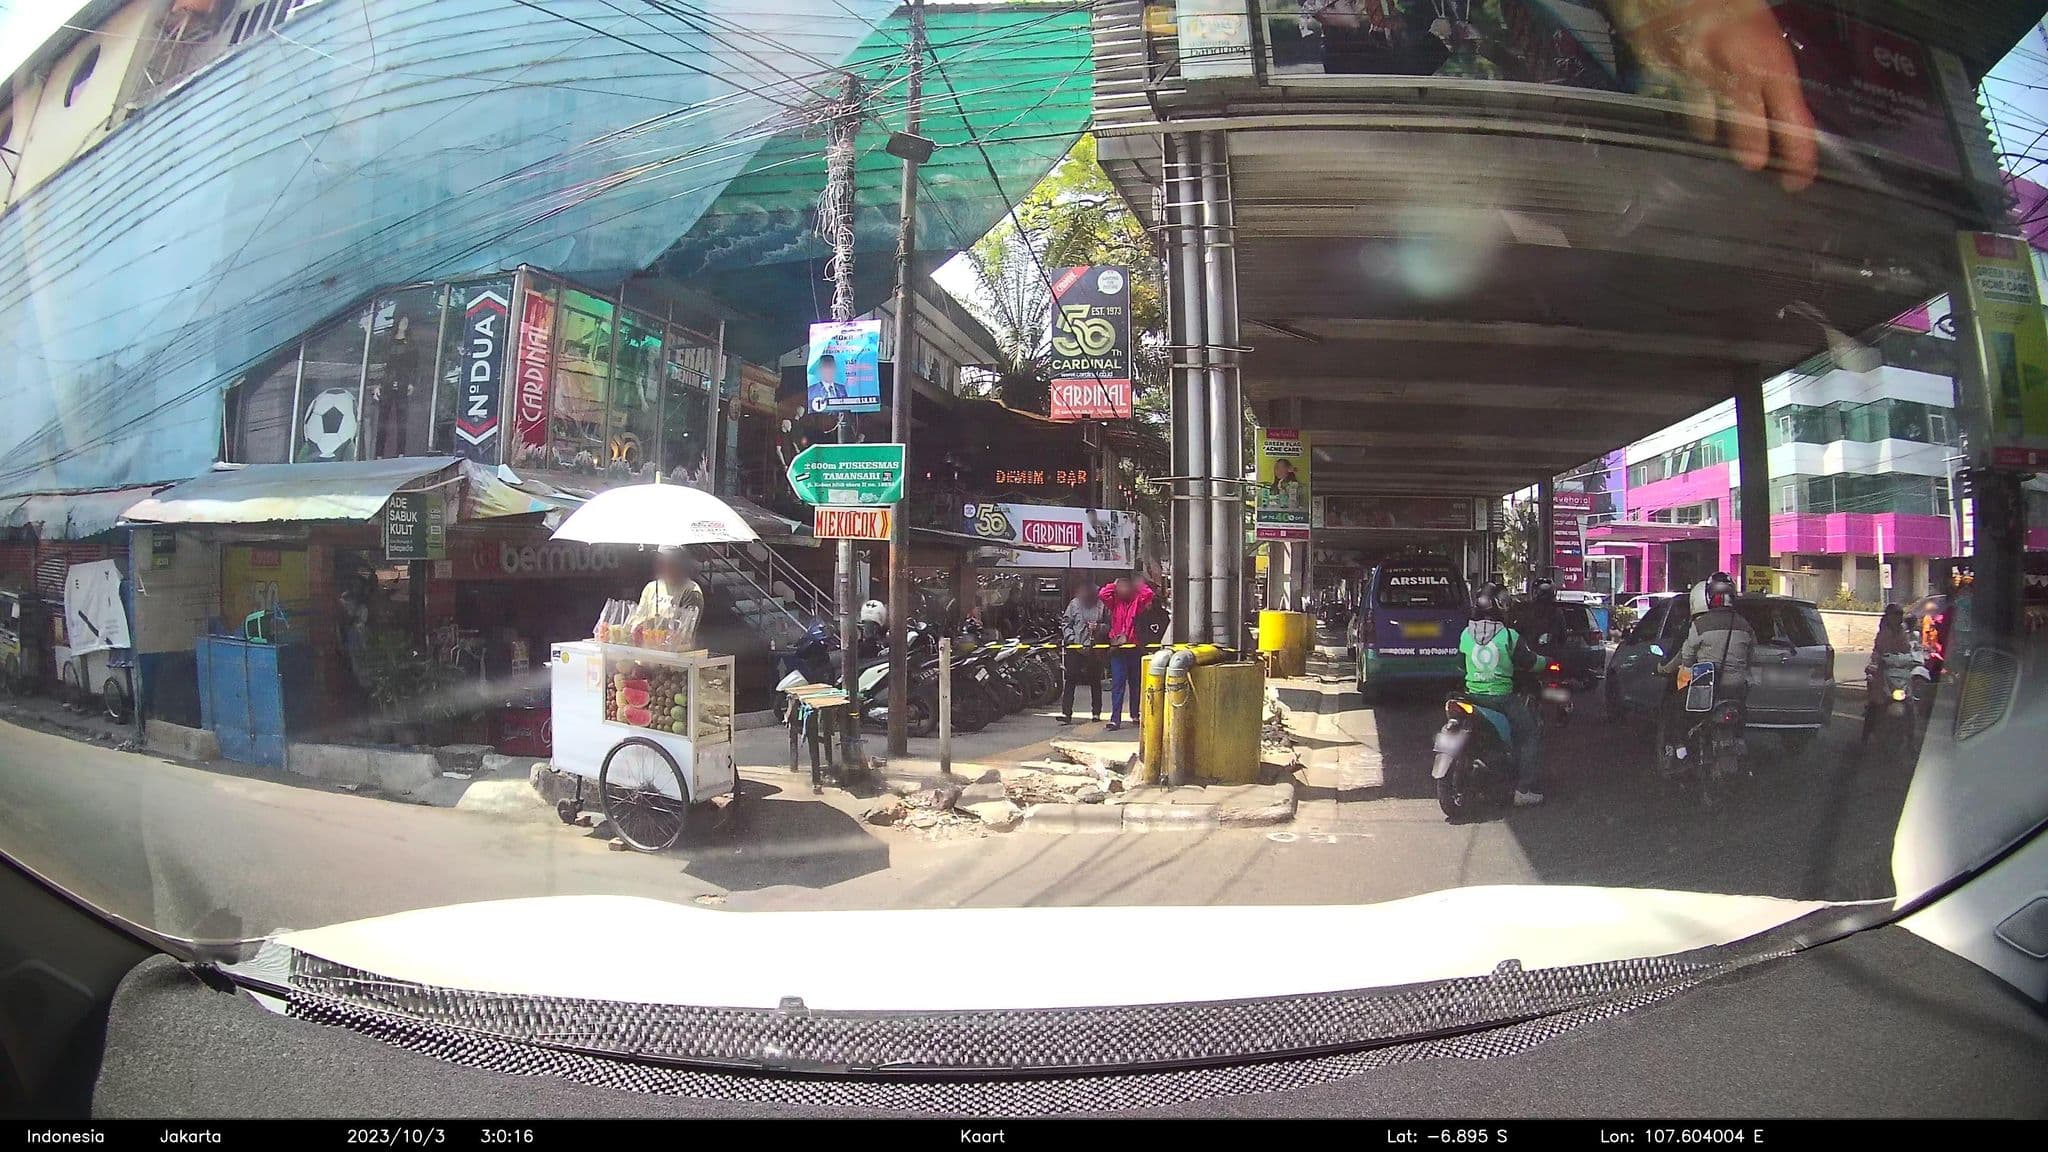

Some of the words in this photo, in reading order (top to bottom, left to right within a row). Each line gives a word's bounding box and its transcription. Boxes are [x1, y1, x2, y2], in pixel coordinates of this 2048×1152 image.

[1107, 306, 1122, 316] 1973
[1052, 359, 1122, 370] CARDINAL
[522, 325, 549, 422] CARDINAL
[1053, 384, 1127, 407] CARDINAL
[838, 461, 899, 470] PUSKESMAS
[823, 472, 881, 480] TAMANSARI
[1056, 470, 1088, 486] BAR
[390, 496, 408, 509] ADE
[390, 510, 418, 523] SABUK
[390, 524, 414, 536] KULIT
[1025, 522, 1079, 545] CARDINAL
